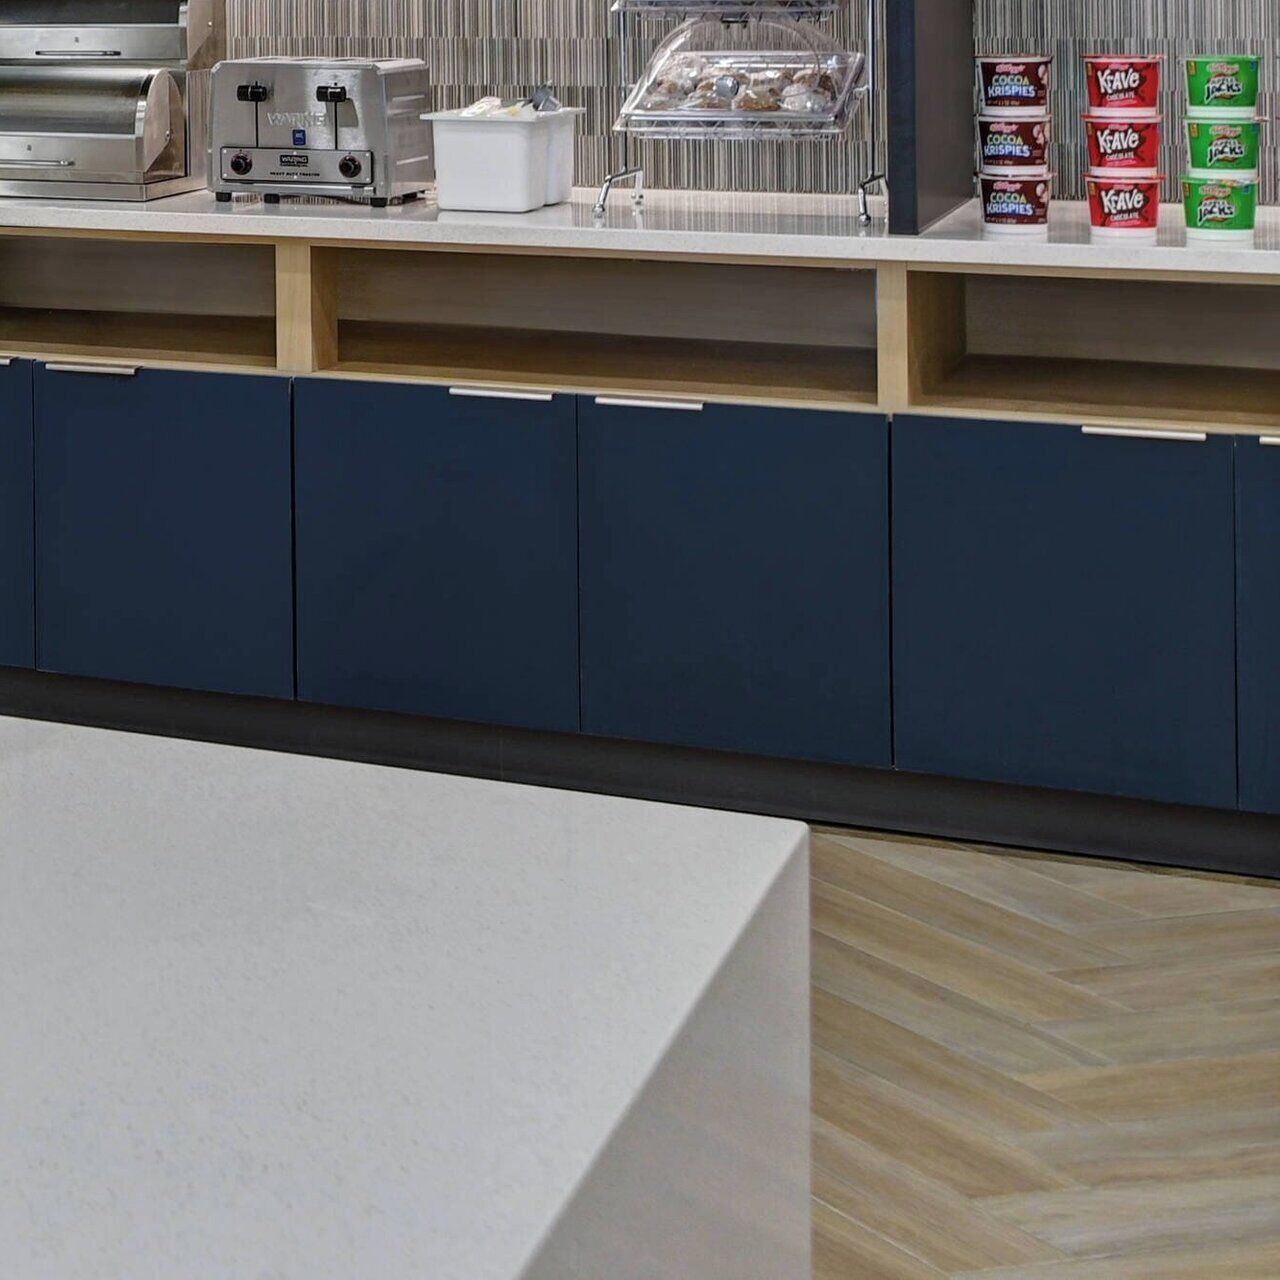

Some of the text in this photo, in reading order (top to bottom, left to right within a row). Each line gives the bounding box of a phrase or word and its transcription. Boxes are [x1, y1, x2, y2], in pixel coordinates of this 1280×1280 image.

[992, 74, 1030, 86] COCOA
[987, 84, 1036, 98] KRISPIES
[987, 134, 1024, 145] COCOA
[983, 144, 1031, 158] KRISPIES
[990, 191, 1027, 204] COCOA
[986, 202, 1033, 216] KRISPIES
